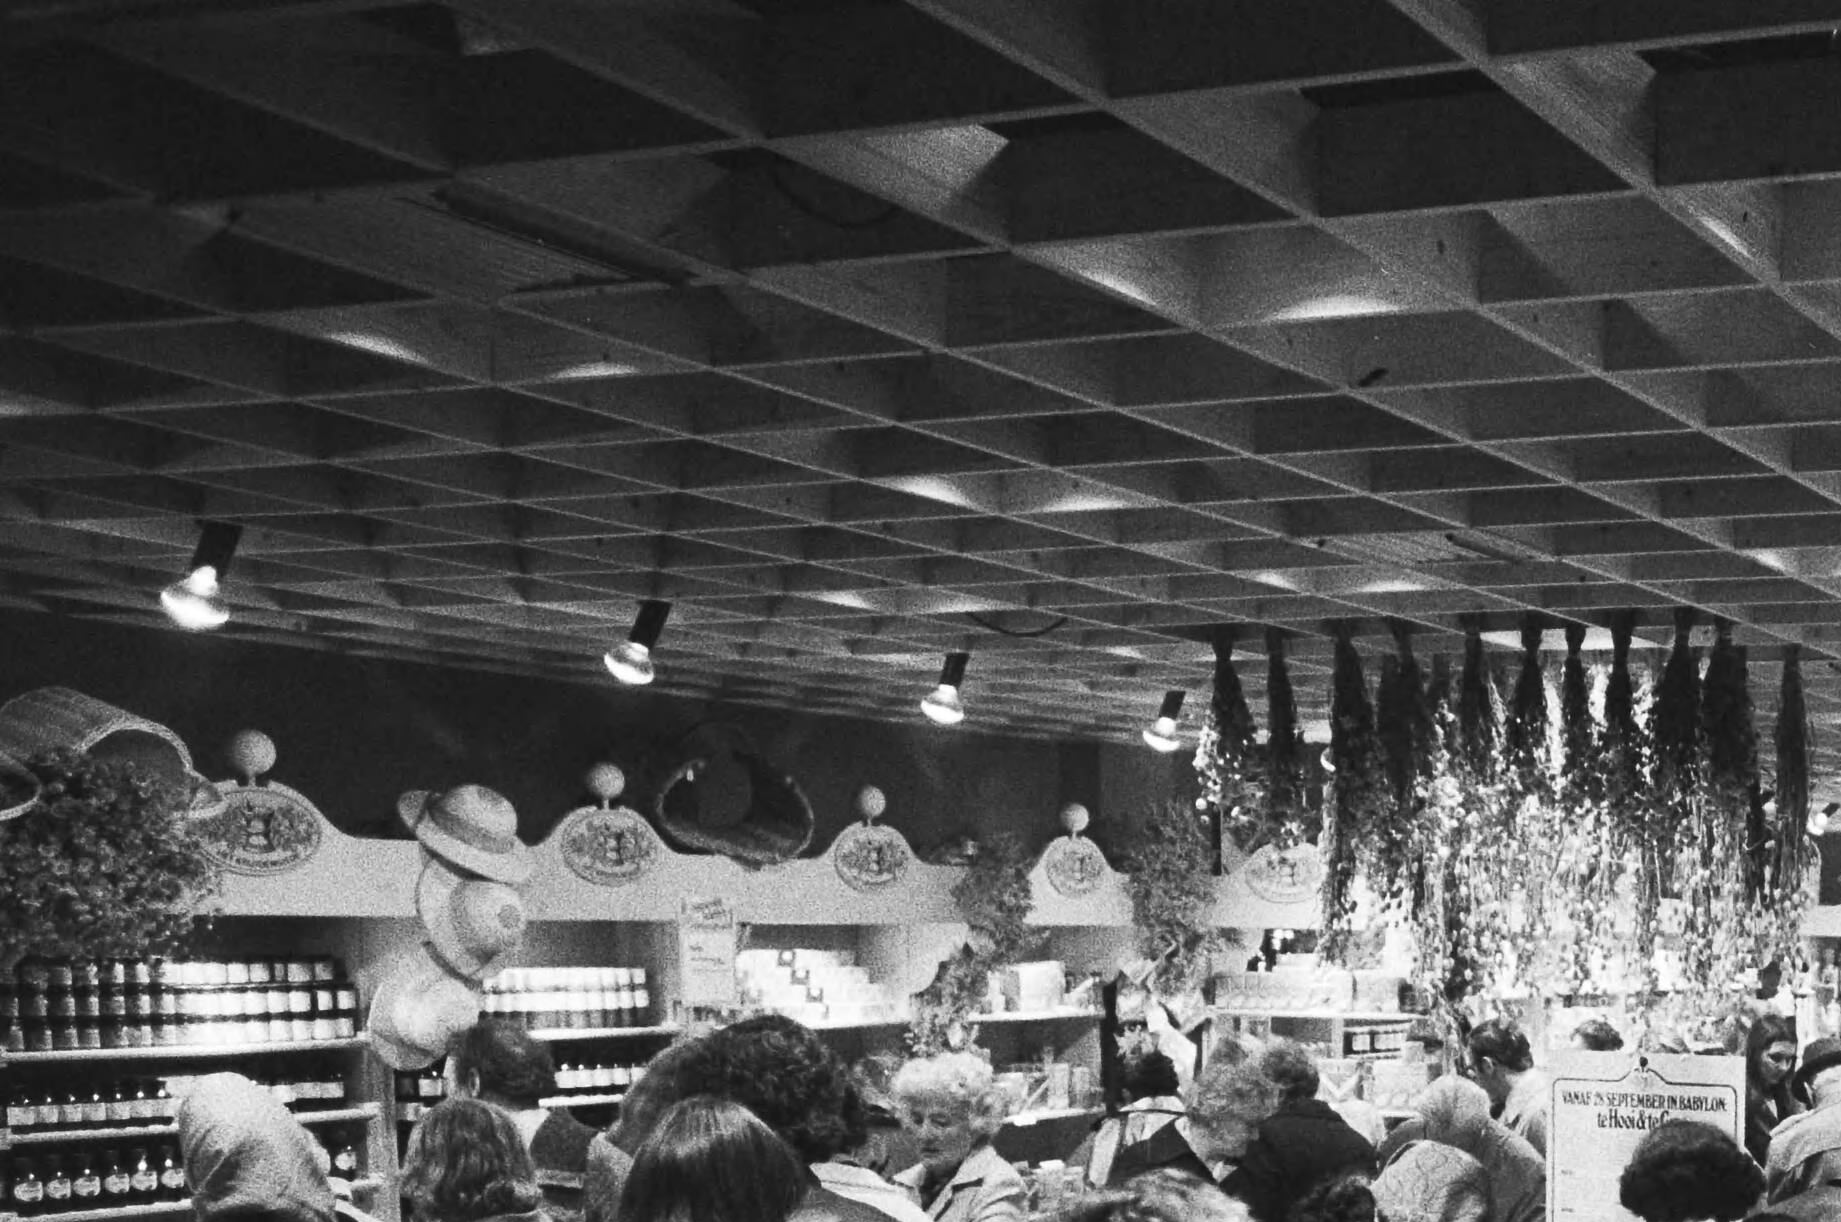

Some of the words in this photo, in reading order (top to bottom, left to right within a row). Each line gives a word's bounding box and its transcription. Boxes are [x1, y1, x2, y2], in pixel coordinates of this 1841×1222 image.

[1562, 1090, 1591, 1106] VANAF
[1606, 1092, 1666, 1110] SEPTEMBER
[1667, 1095, 1679, 1110] IN
[1597, 1111, 1608, 1129] te
[1609, 1109, 1635, 1129] Hooi
[1636, 1109, 1646, 1130] &
